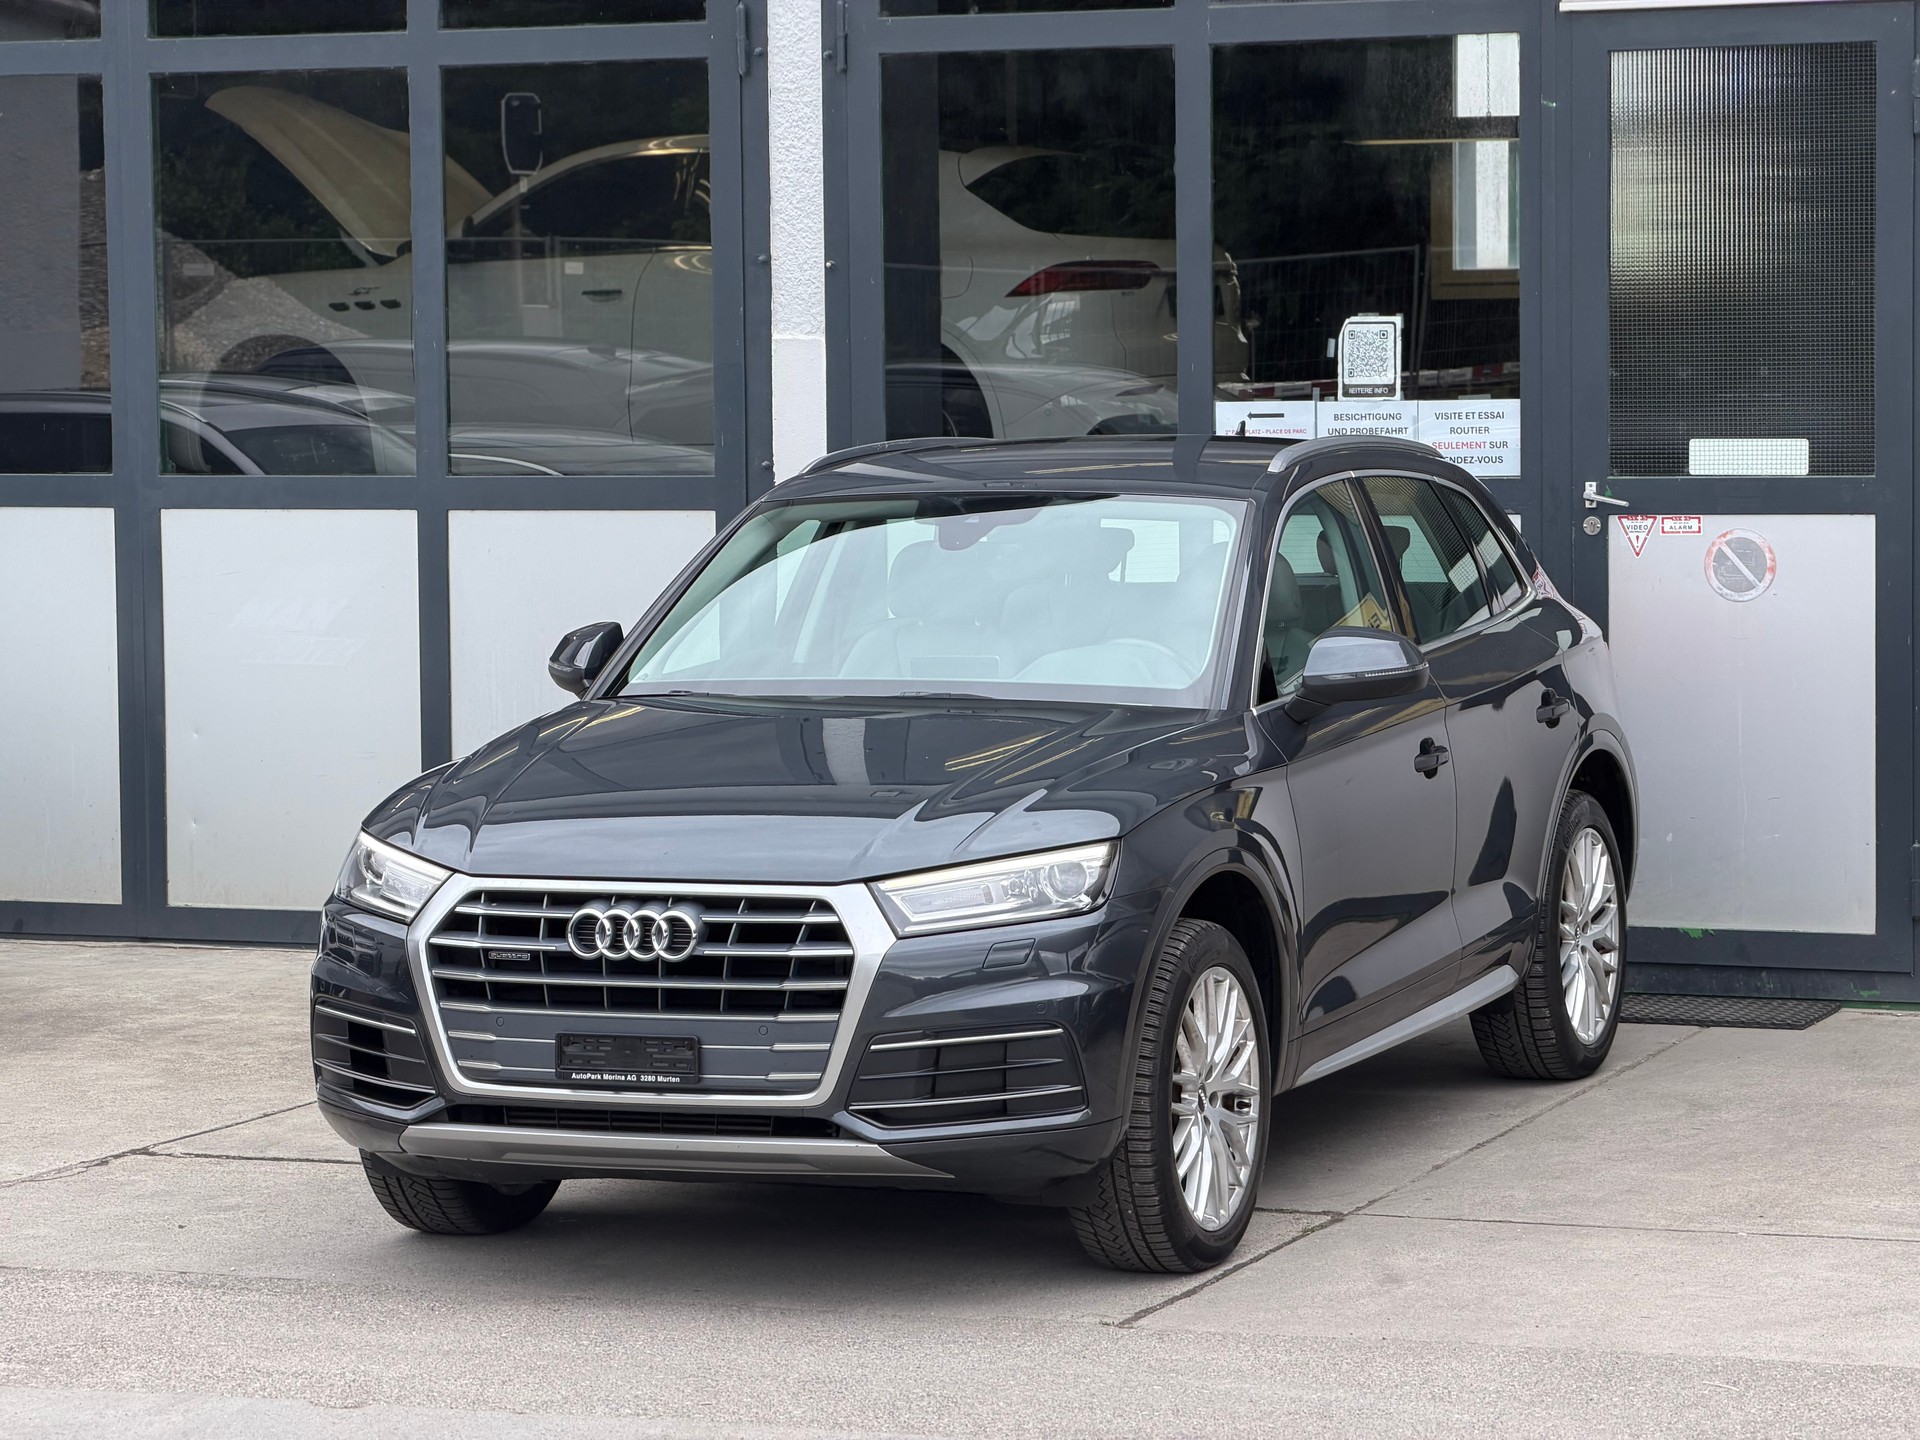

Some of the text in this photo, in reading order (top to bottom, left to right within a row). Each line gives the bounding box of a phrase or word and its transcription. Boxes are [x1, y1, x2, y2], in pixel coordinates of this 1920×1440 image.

[1333, 413, 1402, 421] BESICHTIGUNG
[1434, 411, 1505, 420] VISITE ET ESSAI
[1327, 427, 1409, 436] UND PROBEFAHRT
[1449, 426, 1490, 435] ROUTIER
[1432, 441, 1508, 450] SEULEMENT SUR
[1445, 456, 1504, 465] NDEZ-VOUS
[571, 1072, 602, 1080] AutoPark
[602, 1073, 626, 1081] Morina
